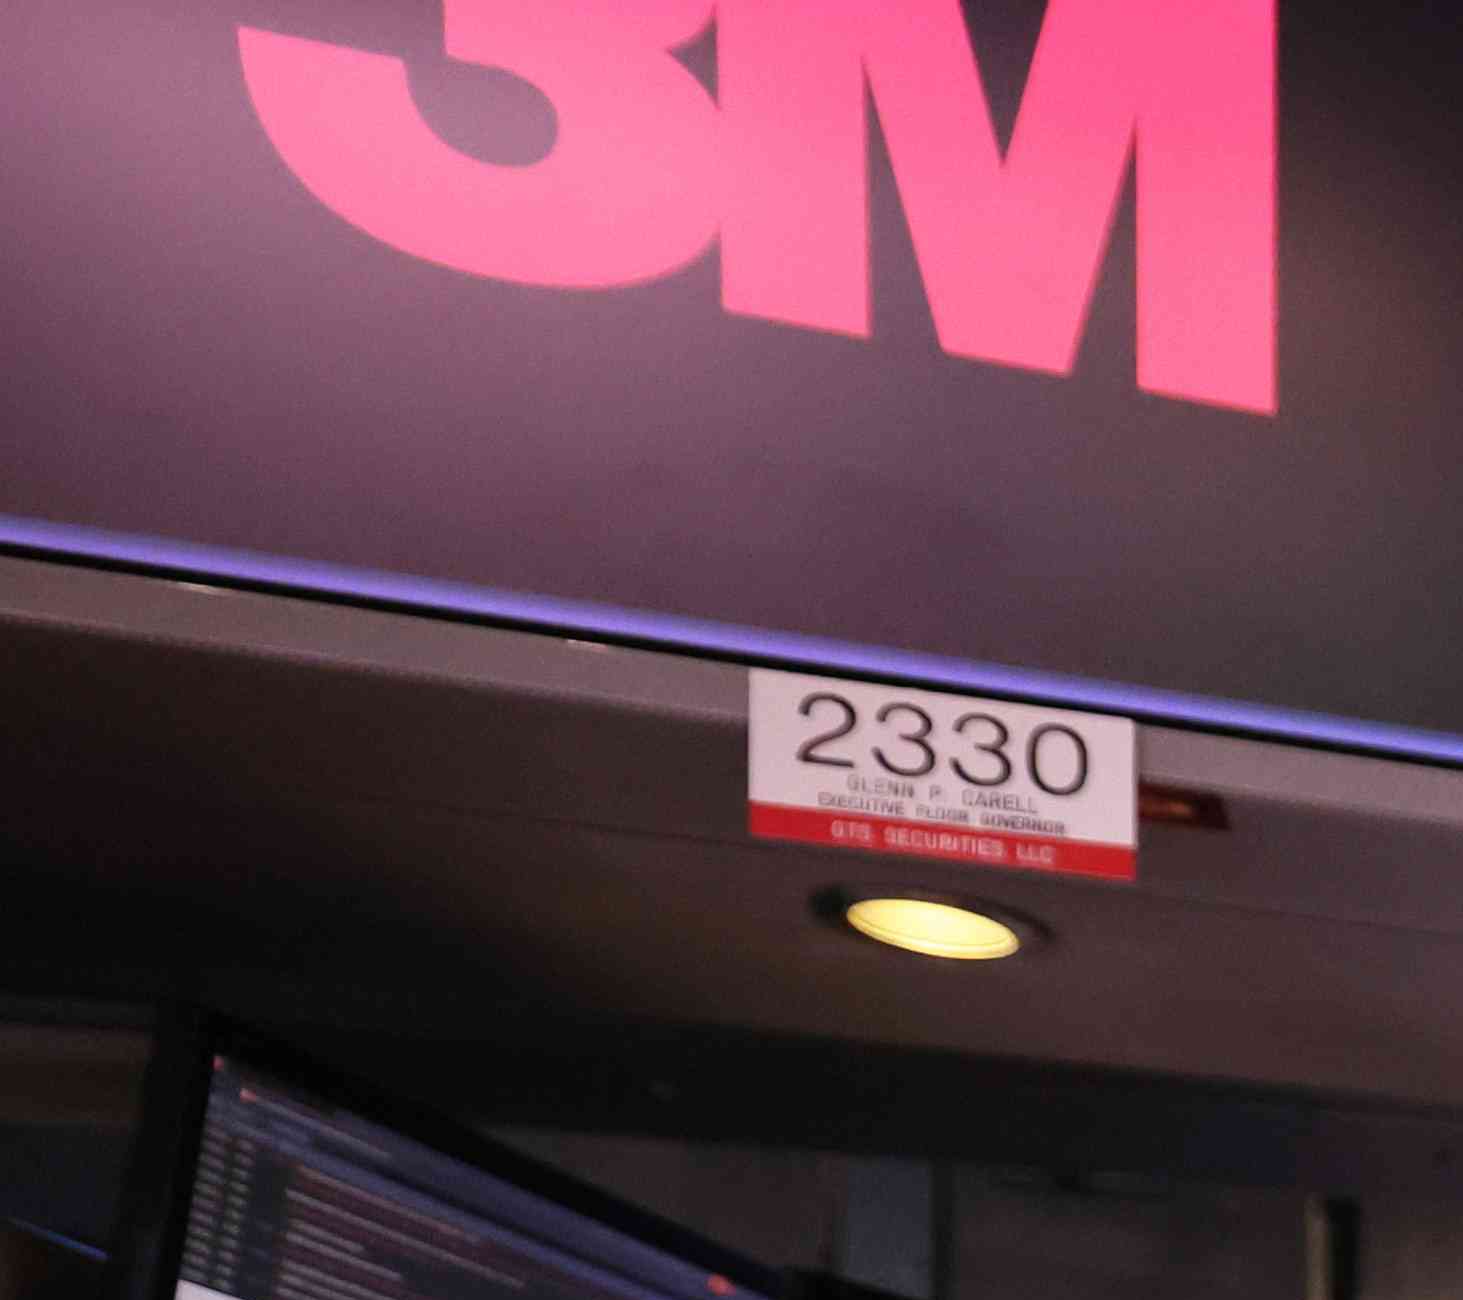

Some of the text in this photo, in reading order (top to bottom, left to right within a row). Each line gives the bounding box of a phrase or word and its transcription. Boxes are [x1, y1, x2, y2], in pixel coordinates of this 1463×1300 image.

[236, 0, 1280, 416] 3M
[797, 690, 1091, 796] 2330
[884, 828, 1005, 859] SECURITIES
